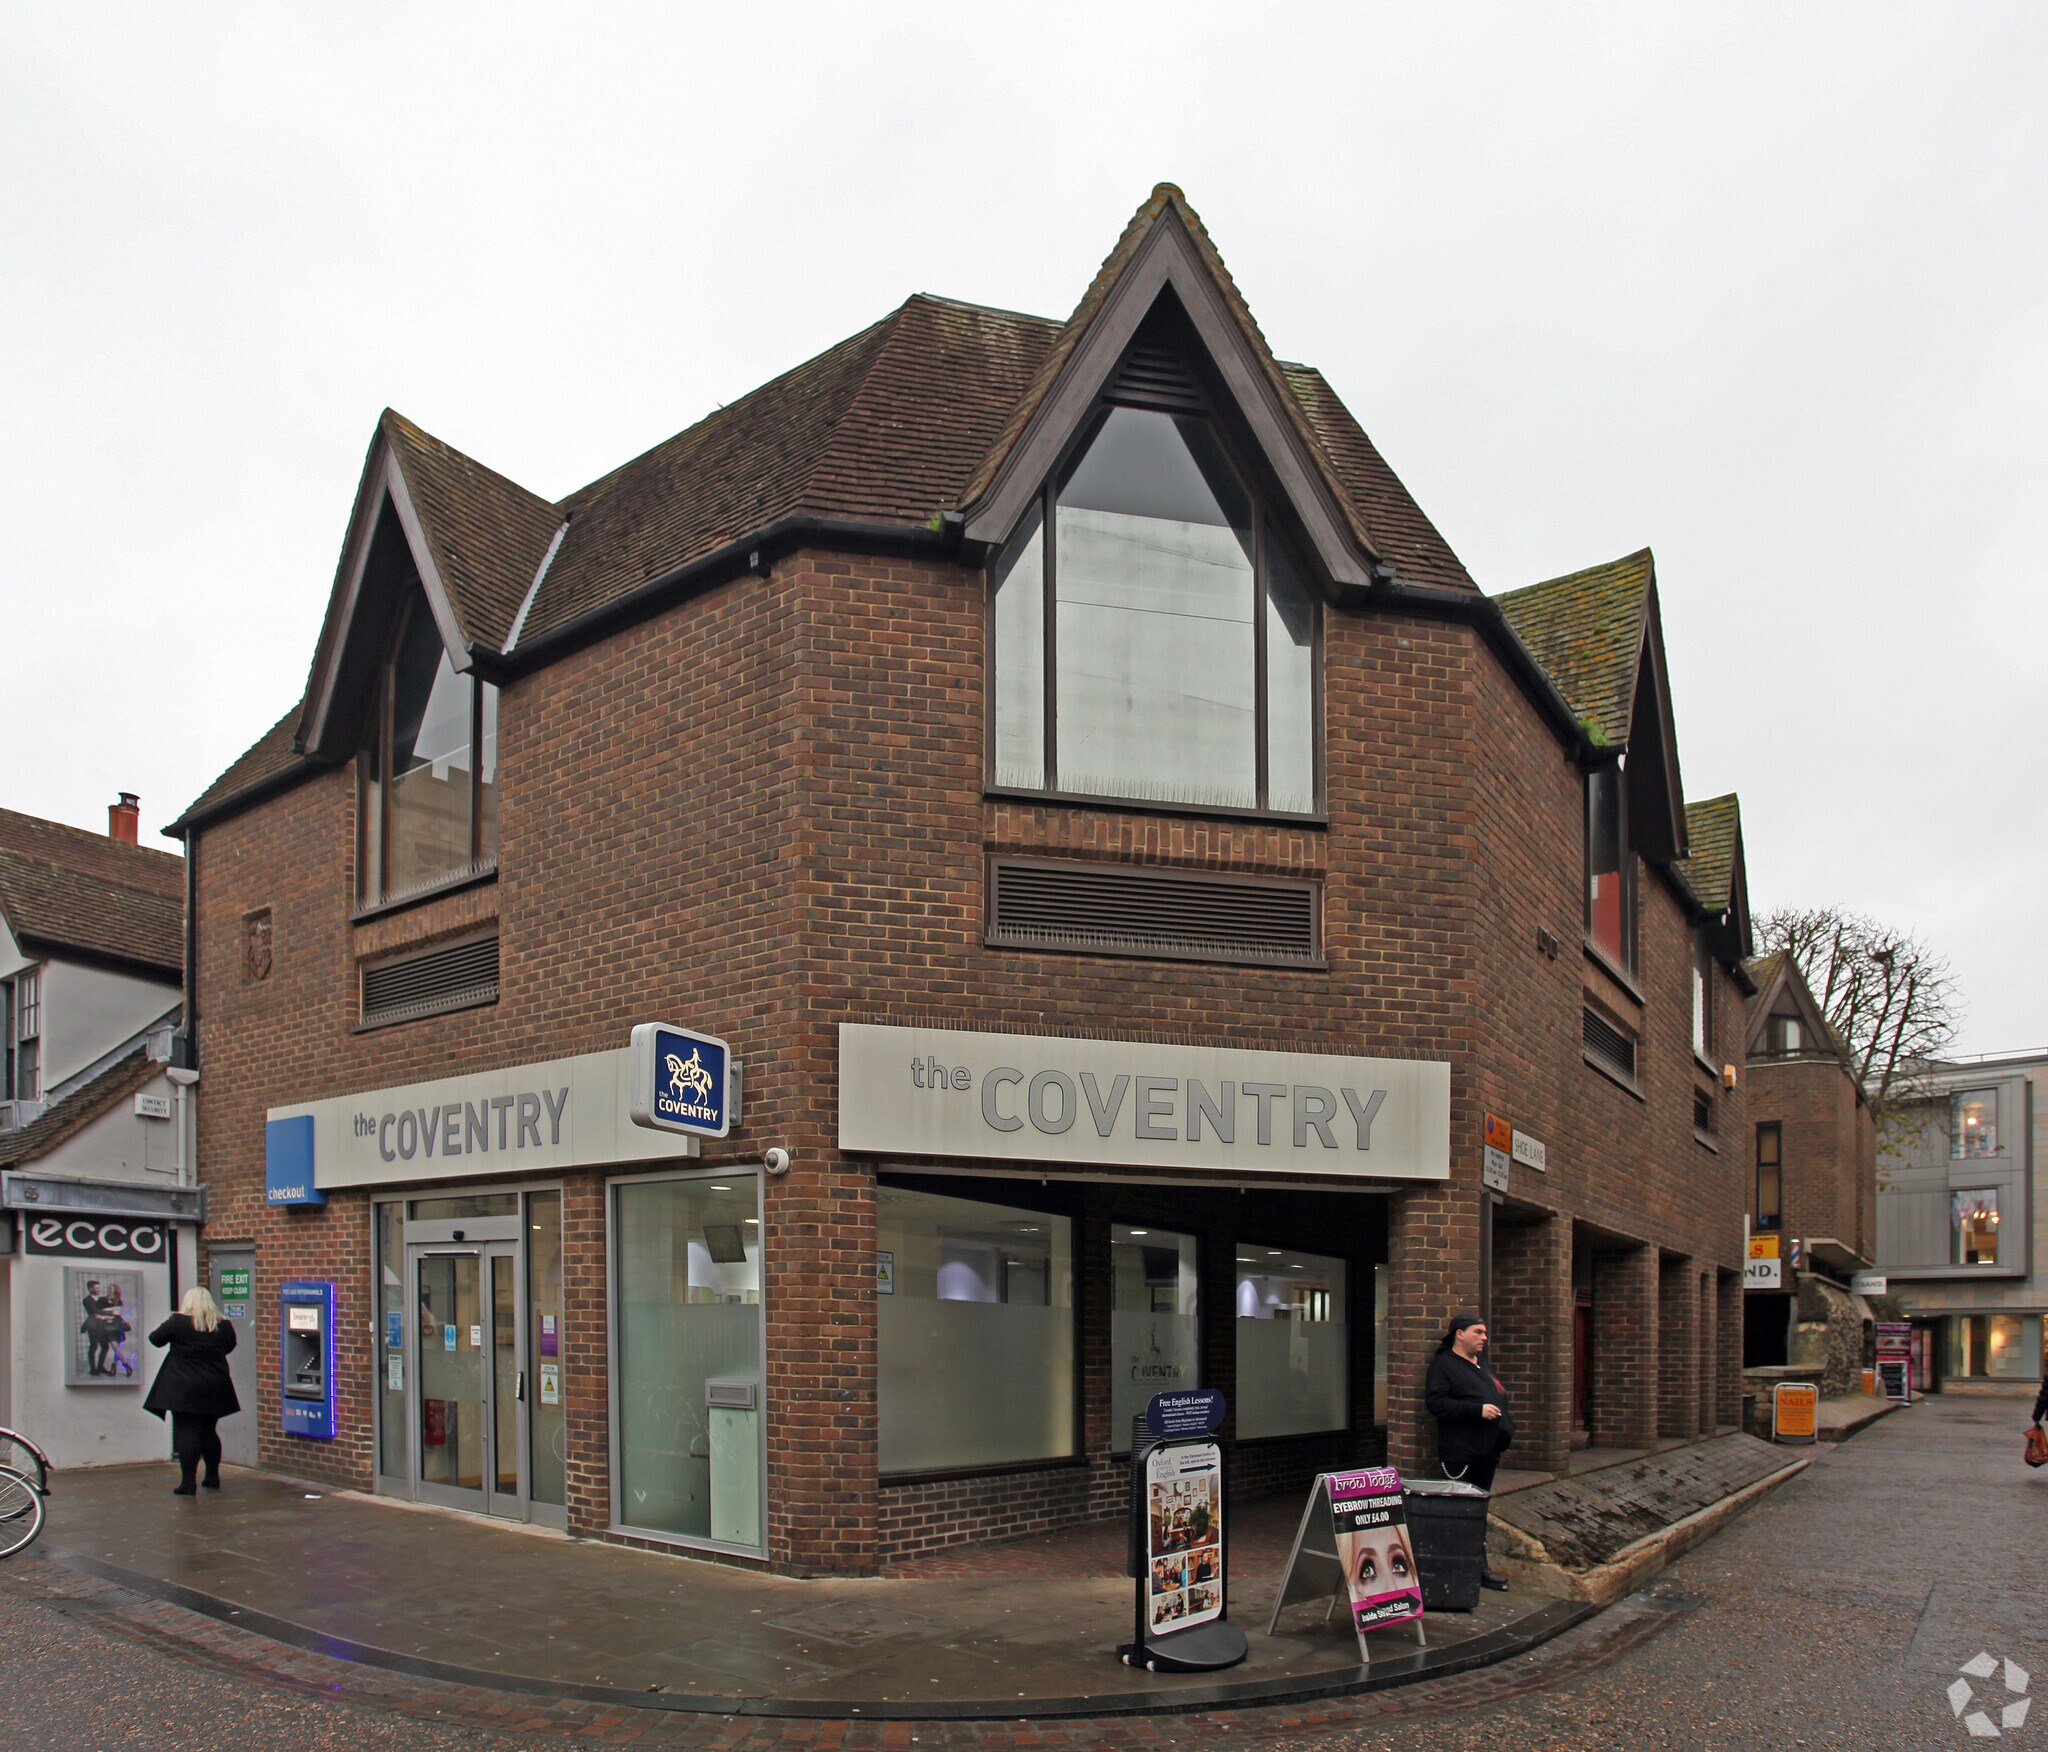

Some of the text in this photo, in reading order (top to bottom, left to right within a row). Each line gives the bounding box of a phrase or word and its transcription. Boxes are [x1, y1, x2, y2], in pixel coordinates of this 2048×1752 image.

[658, 1090, 669, 1099] the
[142, 1106, 167, 1115] SECURITY
[658, 1098, 718, 1122] COVENTRY
[911, 1056, 1388, 1150] the COVENTRY
[353, 1087, 569, 1162] the COVENTRY
[1514, 1138, 1528, 1157] SHOE
[1530, 1145, 1544, 1165] LANE
[268, 1184, 305, 1200] checkout
[31, 1218, 162, 1254] ecco
[221, 1274, 248, 1284] FIRE EXIT
[222, 1287, 248, 1295] KEEP CLEAR
[1159, 1395, 1214, 1408] Free English Lessons!
[1779, 1397, 1814, 1407] NAILS
[1152, 1458, 1171, 1467] Oxford
[1156, 1469, 1175, 1479] English
[1331, 1470, 1397, 1491] brow lodge
[1333, 1495, 1403, 1514] EYEBROW THREADING
[1355, 1511, 1389, 1526] ONLY £4.00
[1361, 1612, 1378, 1622] Inside
[1393, 1602, 1410, 1611] Salon
